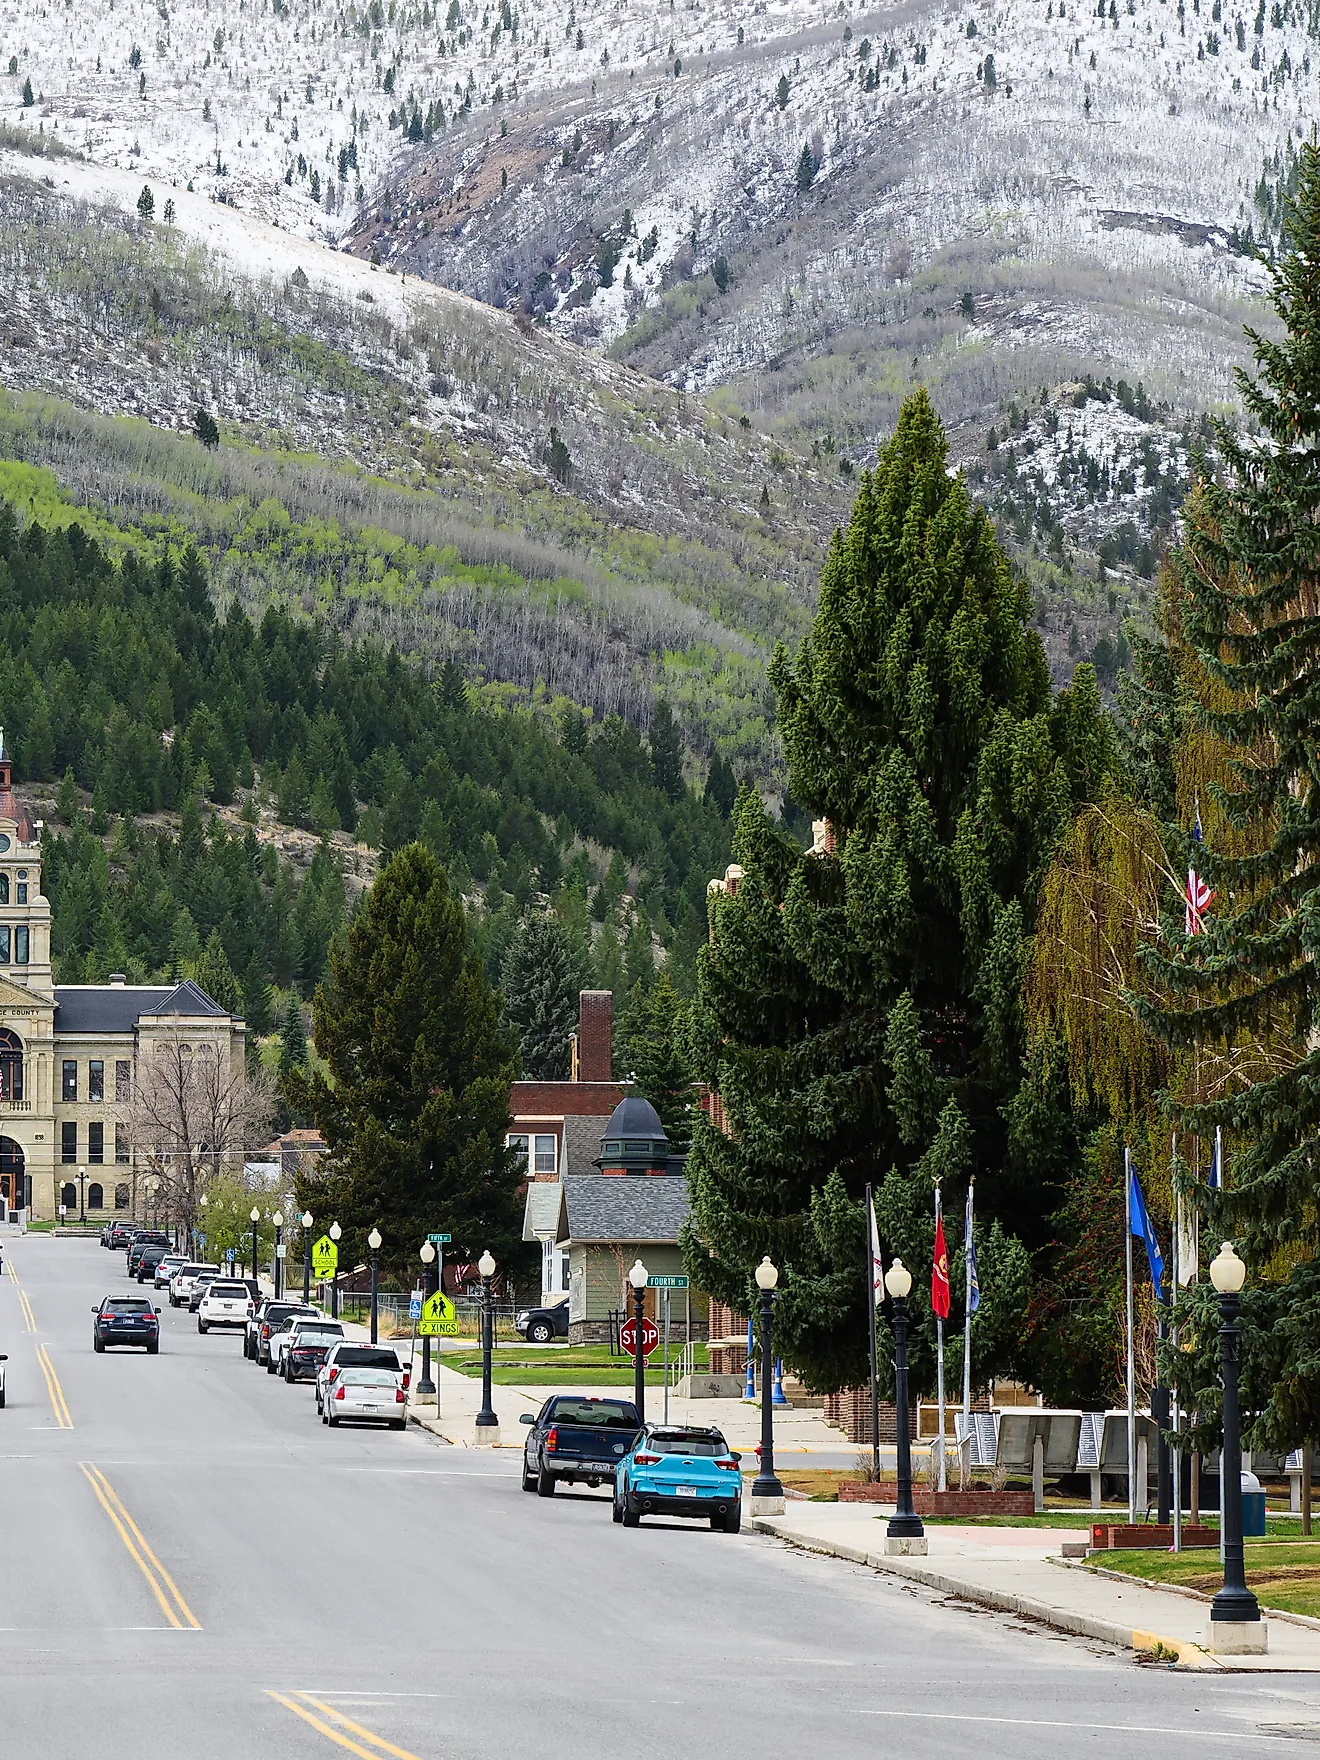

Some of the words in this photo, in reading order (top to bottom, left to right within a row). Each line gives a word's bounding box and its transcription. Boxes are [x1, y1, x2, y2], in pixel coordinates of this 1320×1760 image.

[650, 1277, 676, 1286] FOURTH
[421, 1323, 428, 1333] 2
[430, 1323, 457, 1333] XINGS
